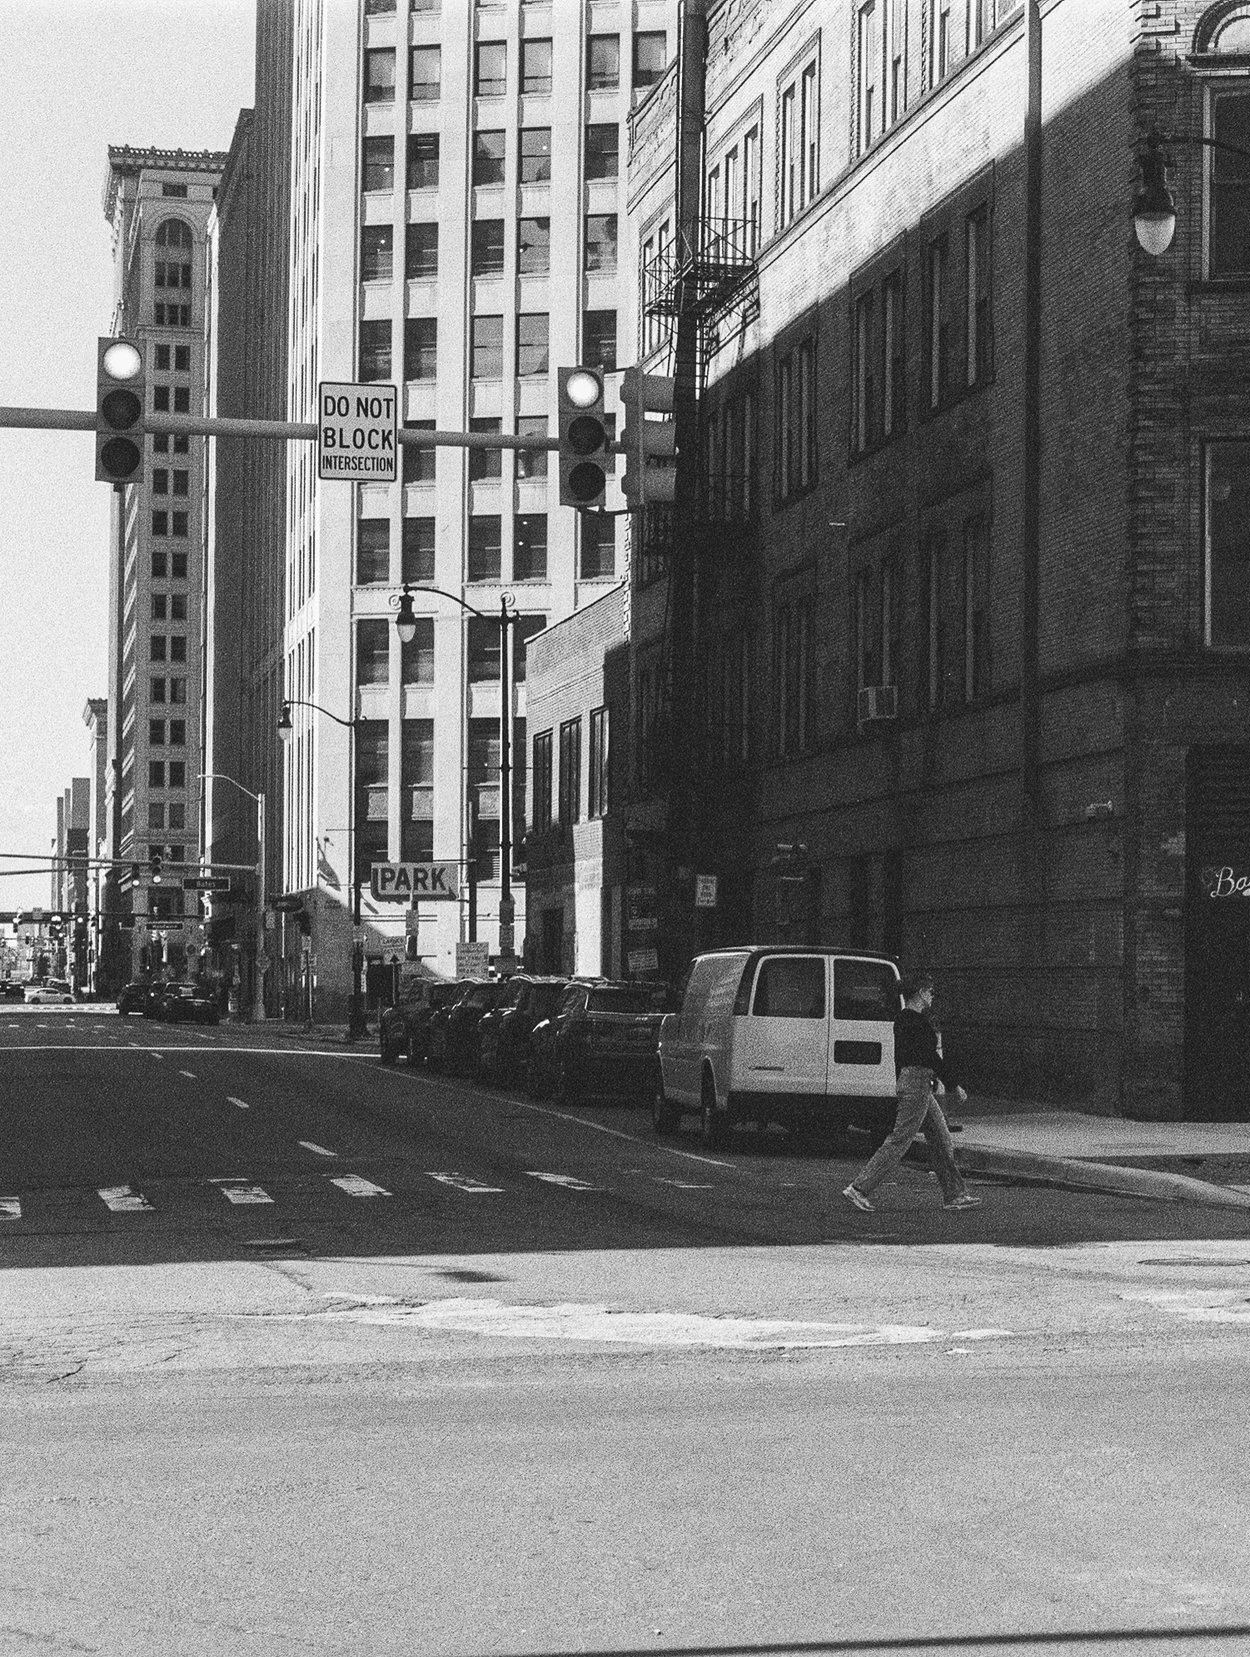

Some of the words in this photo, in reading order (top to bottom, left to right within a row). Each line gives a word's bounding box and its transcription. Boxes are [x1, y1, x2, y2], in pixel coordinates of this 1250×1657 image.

[324, 395, 350, 417] DO
[356, 397, 394, 419] NOT
[323, 427, 393, 450] BLOCK
[322, 455, 394, 472] INTERSECTION
[380, 867, 446, 891] PARK
